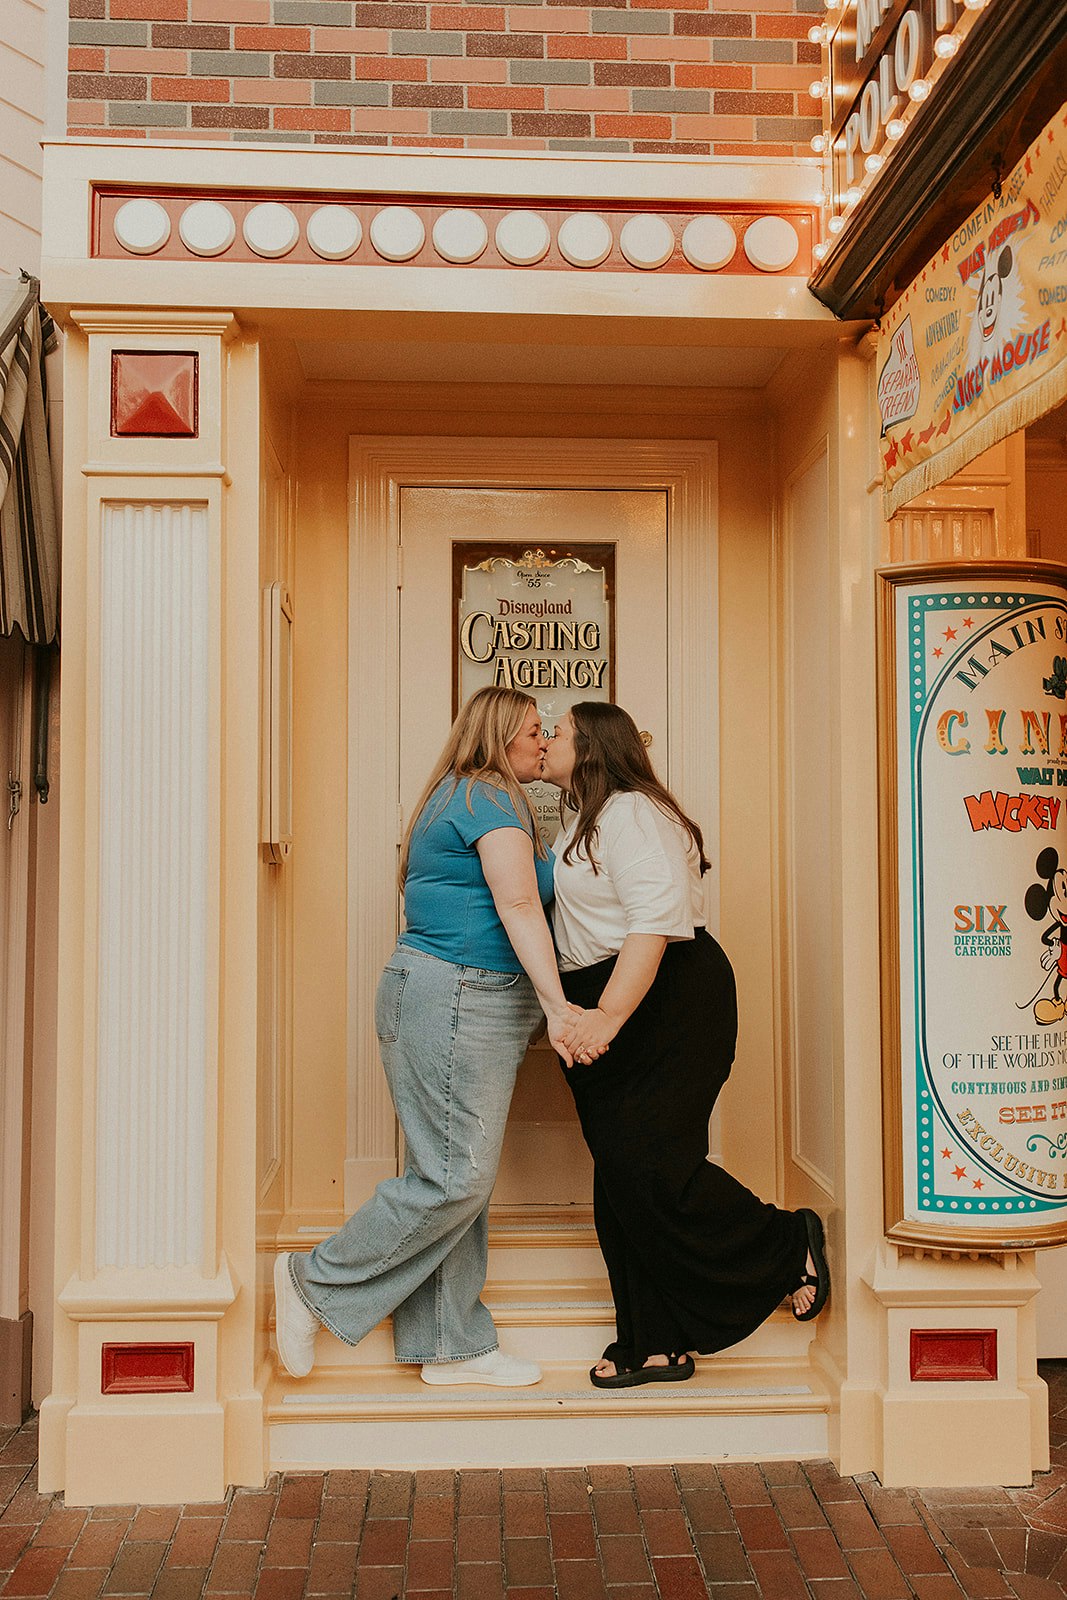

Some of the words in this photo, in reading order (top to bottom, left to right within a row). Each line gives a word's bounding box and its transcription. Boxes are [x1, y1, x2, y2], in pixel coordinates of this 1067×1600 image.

[845, 9, 919, 185] POLO
[952, 211, 982, 253] COME
[925, 287, 957, 303] COMEDY!
[896, 330, 908, 364] SIX
[990, 318, 1051, 385] MOUSE
[526, 578, 541, 588] '55
[497, 598, 572, 618] Disneyland
[460, 611, 601, 663] CASTING
[953, 616, 1046, 693] MAIN
[493, 655, 608, 689] AGENCY
[1016, 767, 1054, 786] WALT
[963, 790, 1061, 832] MICKEY
[953, 905, 1010, 933] SIX
[954, 935, 1012, 946] DIFFERENT
[954, 946, 1012, 957] CARTOONS
[991, 1035, 1012, 1051] SEE
[1015, 1034, 1040, 1050] THE
[942, 1053, 962, 1069] OF
[967, 1053, 998, 1069] THE
[1003, 1050, 1055, 1068] WORLD'S
[951, 1081, 1027, 1095] CONTINUOUS
[1030, 1080, 1050, 1093] AND
[999, 1105, 1047, 1124] SEE
[1051, 1101, 1067, 1120] IT
[956, 1108, 1058, 1189] EXCLUSIVE
